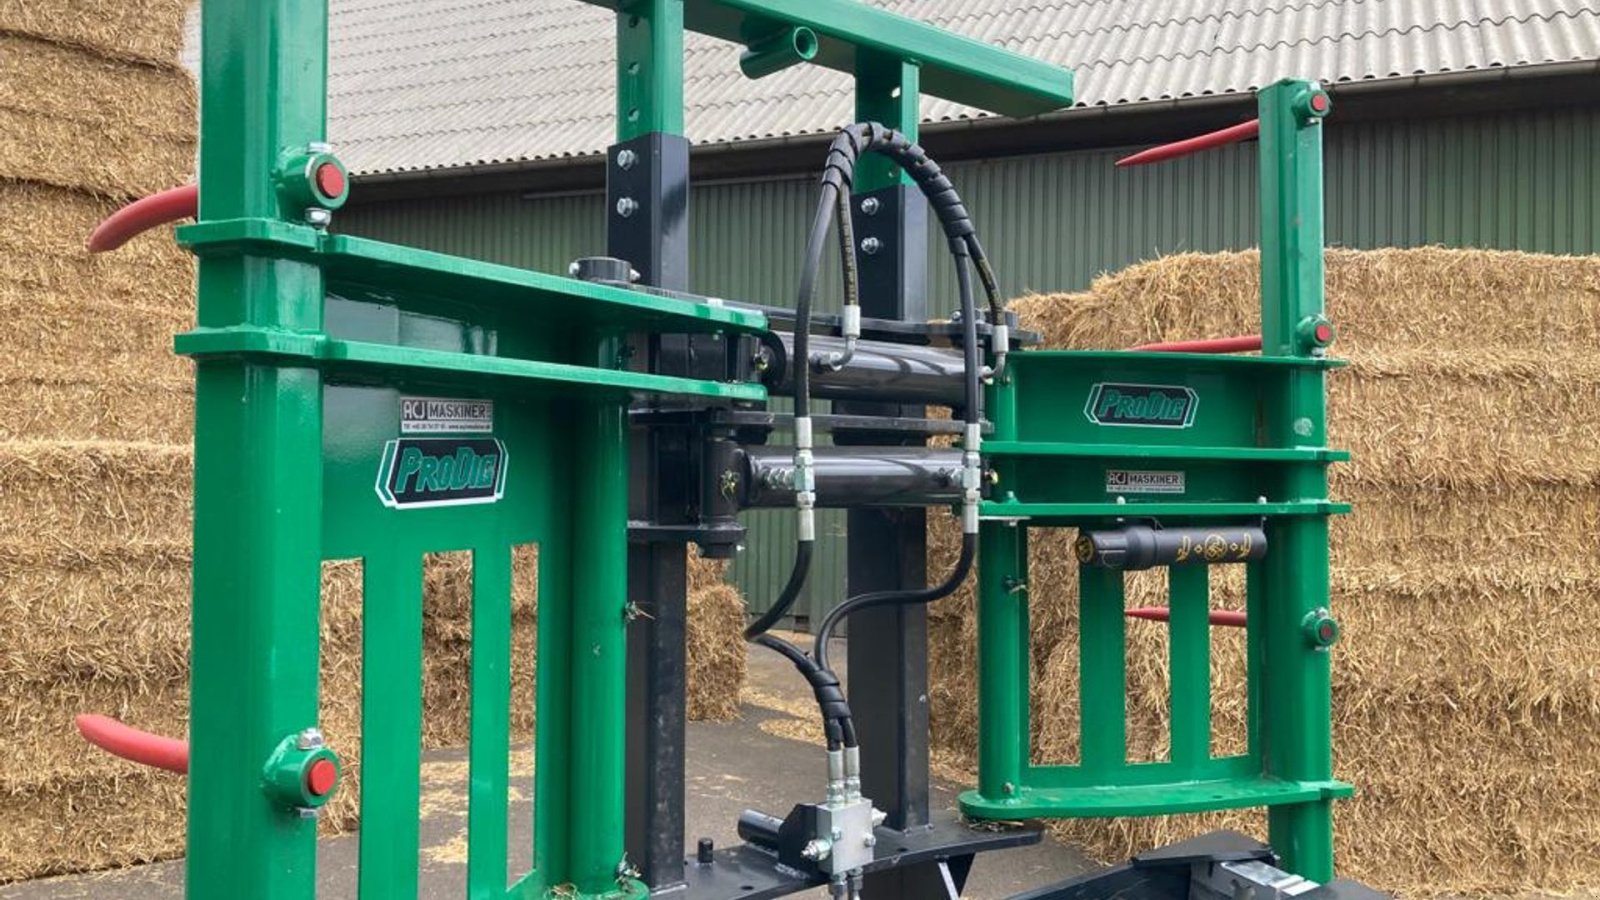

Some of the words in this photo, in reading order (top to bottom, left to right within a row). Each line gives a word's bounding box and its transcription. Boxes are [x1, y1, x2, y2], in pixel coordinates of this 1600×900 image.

[403, 401, 426, 420] ACJ
[429, 403, 486, 419] MASKINER
[1129, 474, 1179, 484] MASKINER
